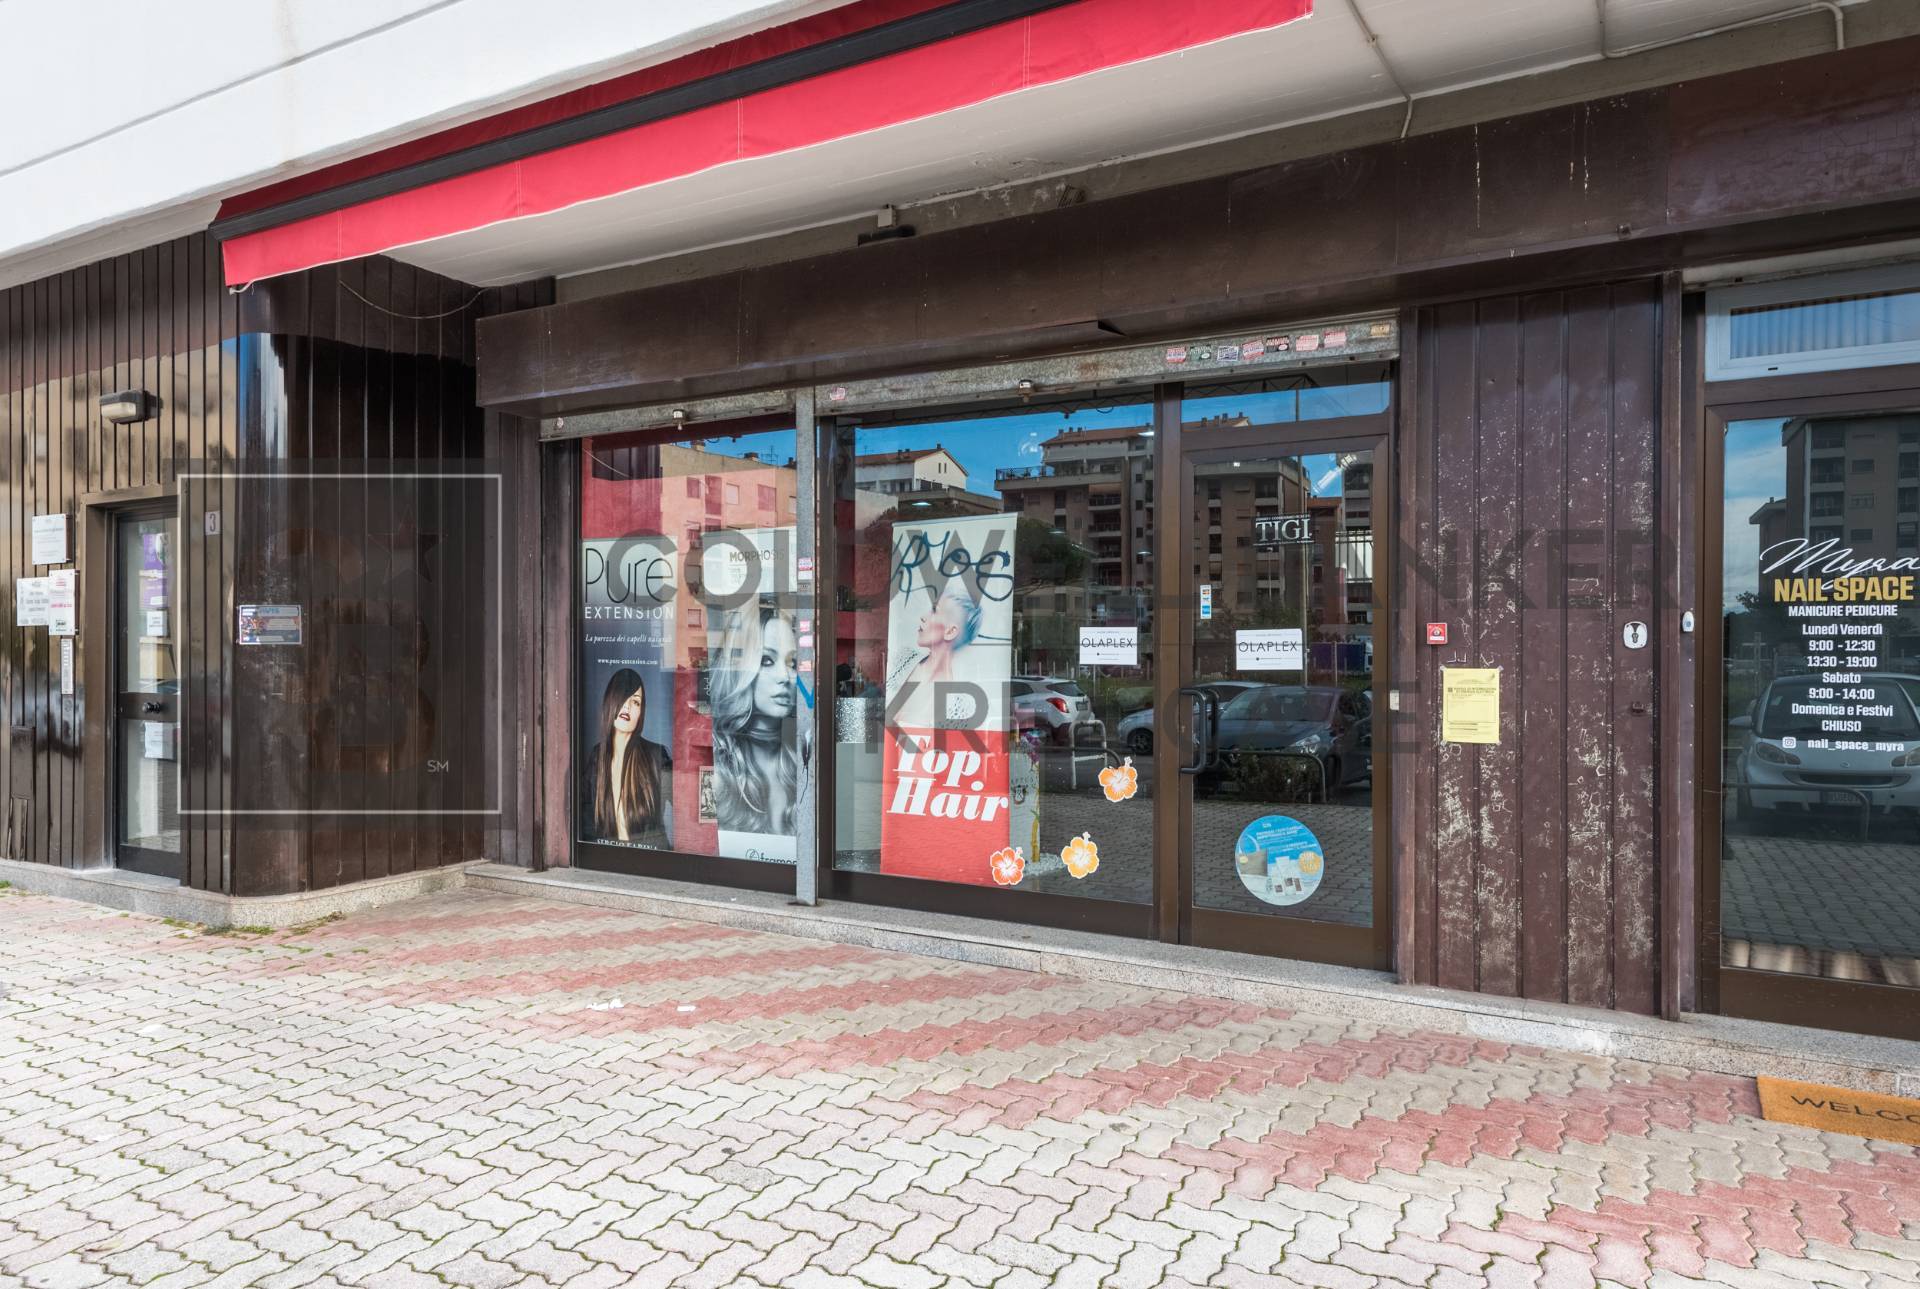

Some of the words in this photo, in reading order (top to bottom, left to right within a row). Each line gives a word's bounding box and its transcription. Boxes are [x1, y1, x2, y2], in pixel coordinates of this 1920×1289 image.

[209, 513, 216, 532] 3
[1760, 537, 1920, 590] Myra
[585, 548, 673, 603] Pure
[1774, 577, 1828, 602] NAIL
[1833, 576, 1914, 601] SPACE
[584, 606, 674, 619] EXTENSION
[1788, 606, 1843, 617] MANICURE
[1845, 605, 1898, 616] PEDICURE
[1081, 637, 1133, 648] OLAPLEX
[1238, 641, 1298, 652] OLAPLEX
[1808, 640, 1834, 651] 9:00
[1844, 640, 1876, 651] 12:30
[1807, 656, 1837, 667] 13:30
[1846, 656, 1877, 668] 19:00
[1822, 672, 1861, 683] Sabato
[1808, 688, 1834, 699] 9:00
[1842, 688, 1875, 699] 14:00
[1792, 703, 1845, 715] Domenica
[1847, 707, 1855, 715] e
[1856, 705, 1893, 717] Festivi
[1821, 720, 1862, 732] CHIUSO
[1807, 739, 1904, 752] nail_space_myra
[893, 734, 981, 788] Top
[886, 776, 1009, 822] Hair
